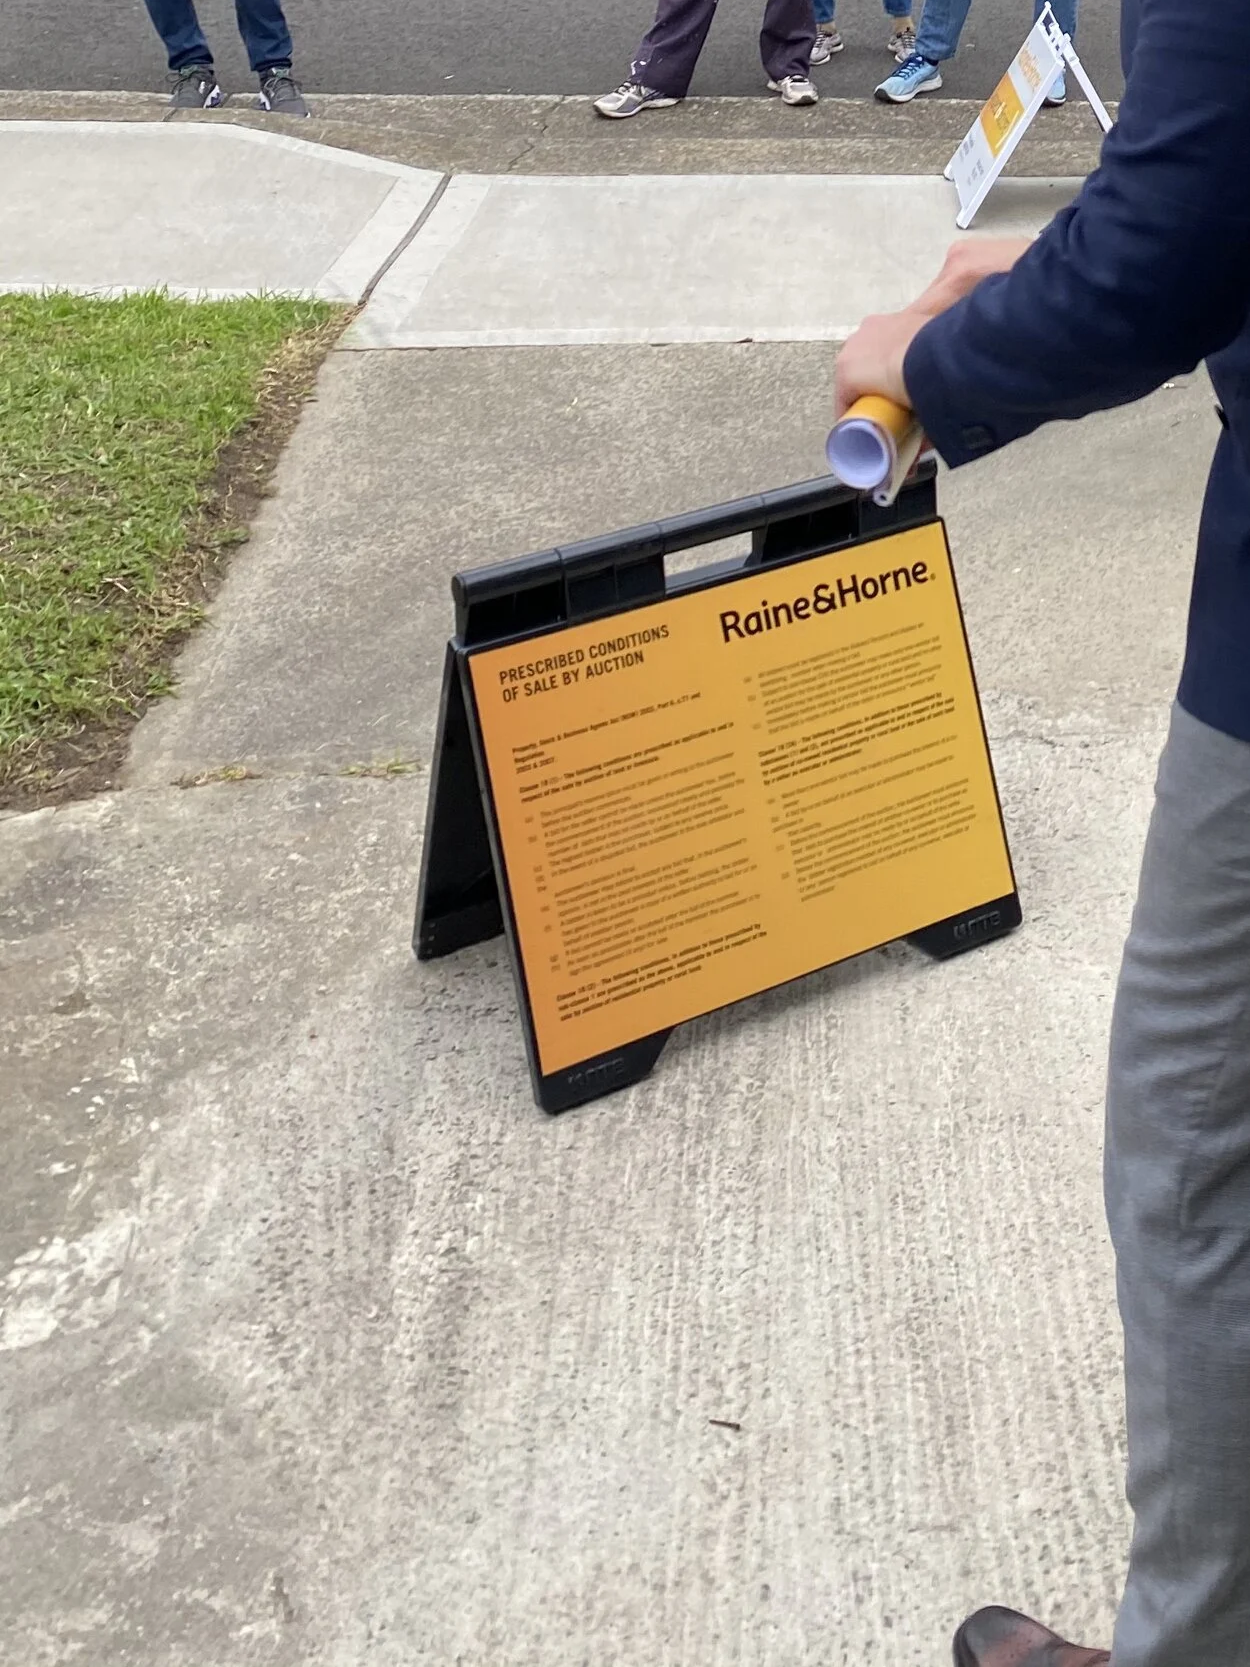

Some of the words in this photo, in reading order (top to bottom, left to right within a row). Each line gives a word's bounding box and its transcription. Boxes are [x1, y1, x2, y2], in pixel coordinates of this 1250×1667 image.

[499, 649, 585, 685] PRESCRIBED
[589, 624, 670, 660] CONDITIONS
[502, 686, 519, 704] OF
[524, 675, 559, 697] SALE
[562, 669, 580, 687] BY
[585, 650, 645, 679] AUCTION
